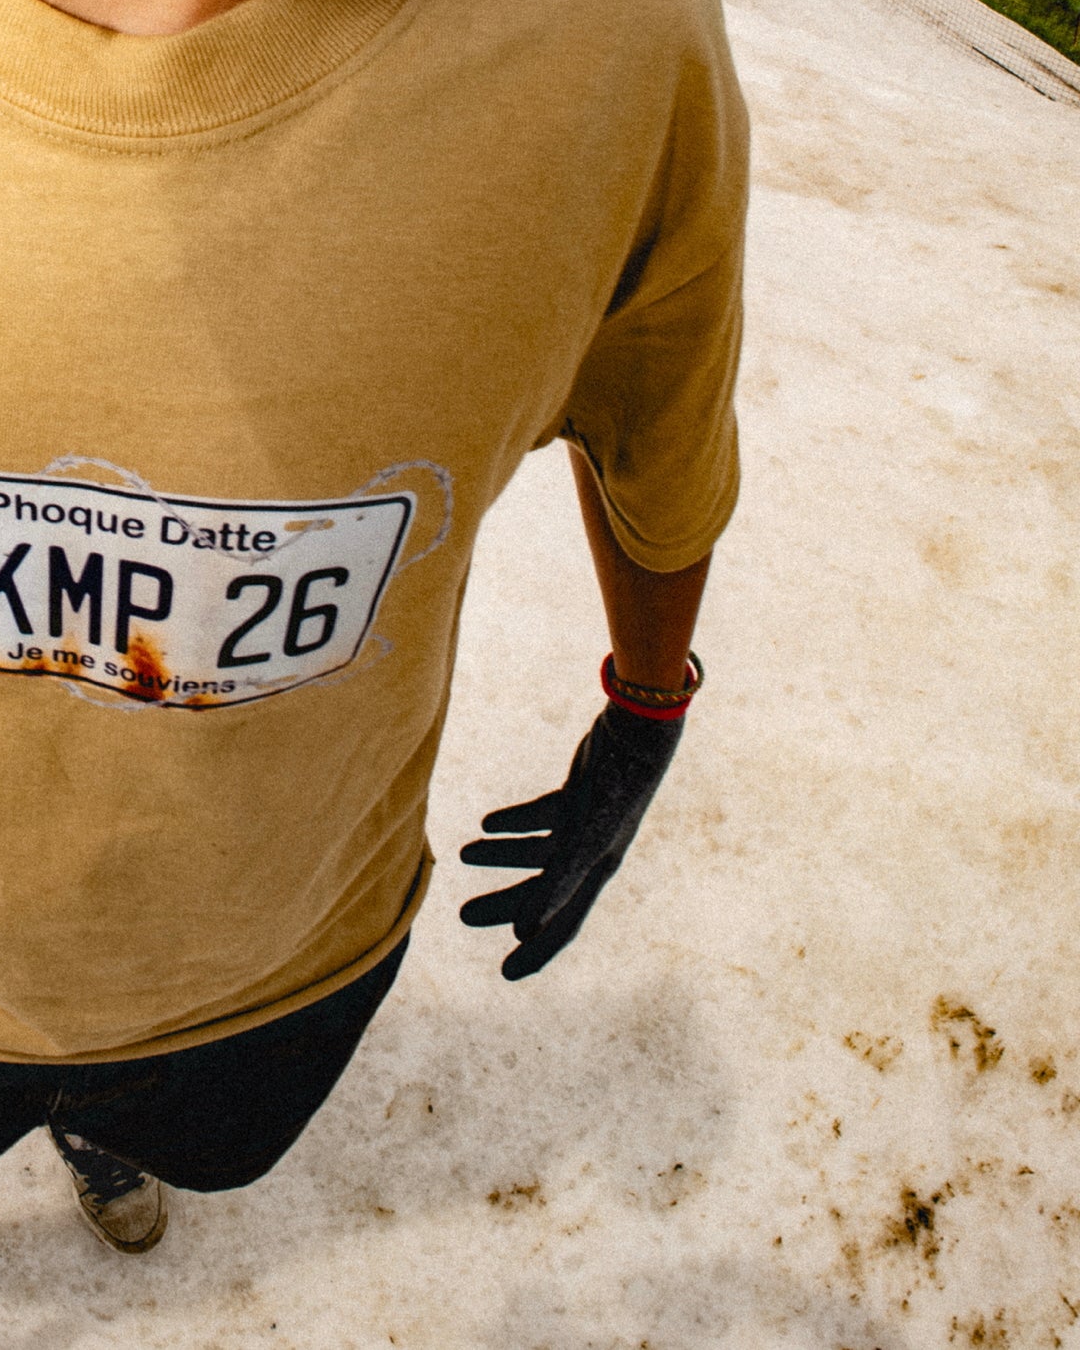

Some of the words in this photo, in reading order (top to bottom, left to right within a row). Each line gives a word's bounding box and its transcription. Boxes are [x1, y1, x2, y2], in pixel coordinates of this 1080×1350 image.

[160, 515, 276, 552] Datte
[217, 566, 349, 669] 26
[8, 642, 43, 660] Je
[52, 648, 95, 669] me
[104, 661, 236, 694] souviens
